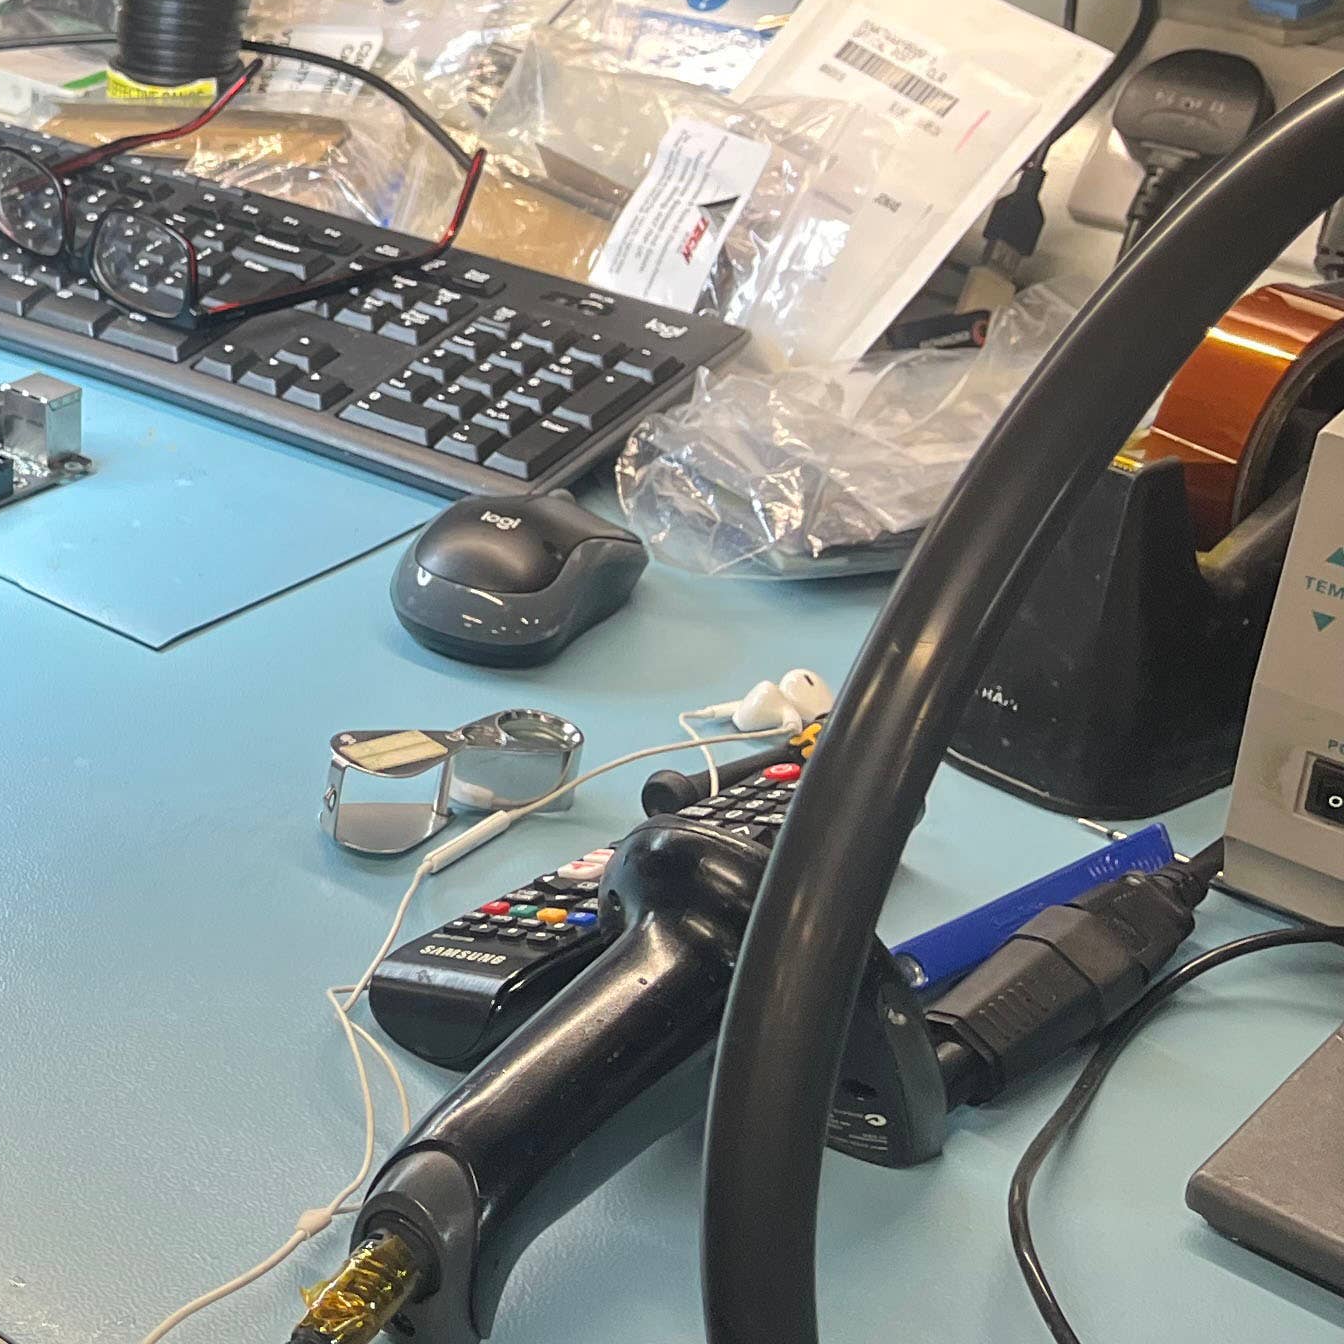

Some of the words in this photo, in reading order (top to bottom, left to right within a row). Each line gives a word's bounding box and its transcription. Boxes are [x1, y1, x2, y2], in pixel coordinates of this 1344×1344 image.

[645, 318, 688, 338] logi
[481, 510, 522, 530] logi
[420, 945, 507, 965] SAMSUNG
